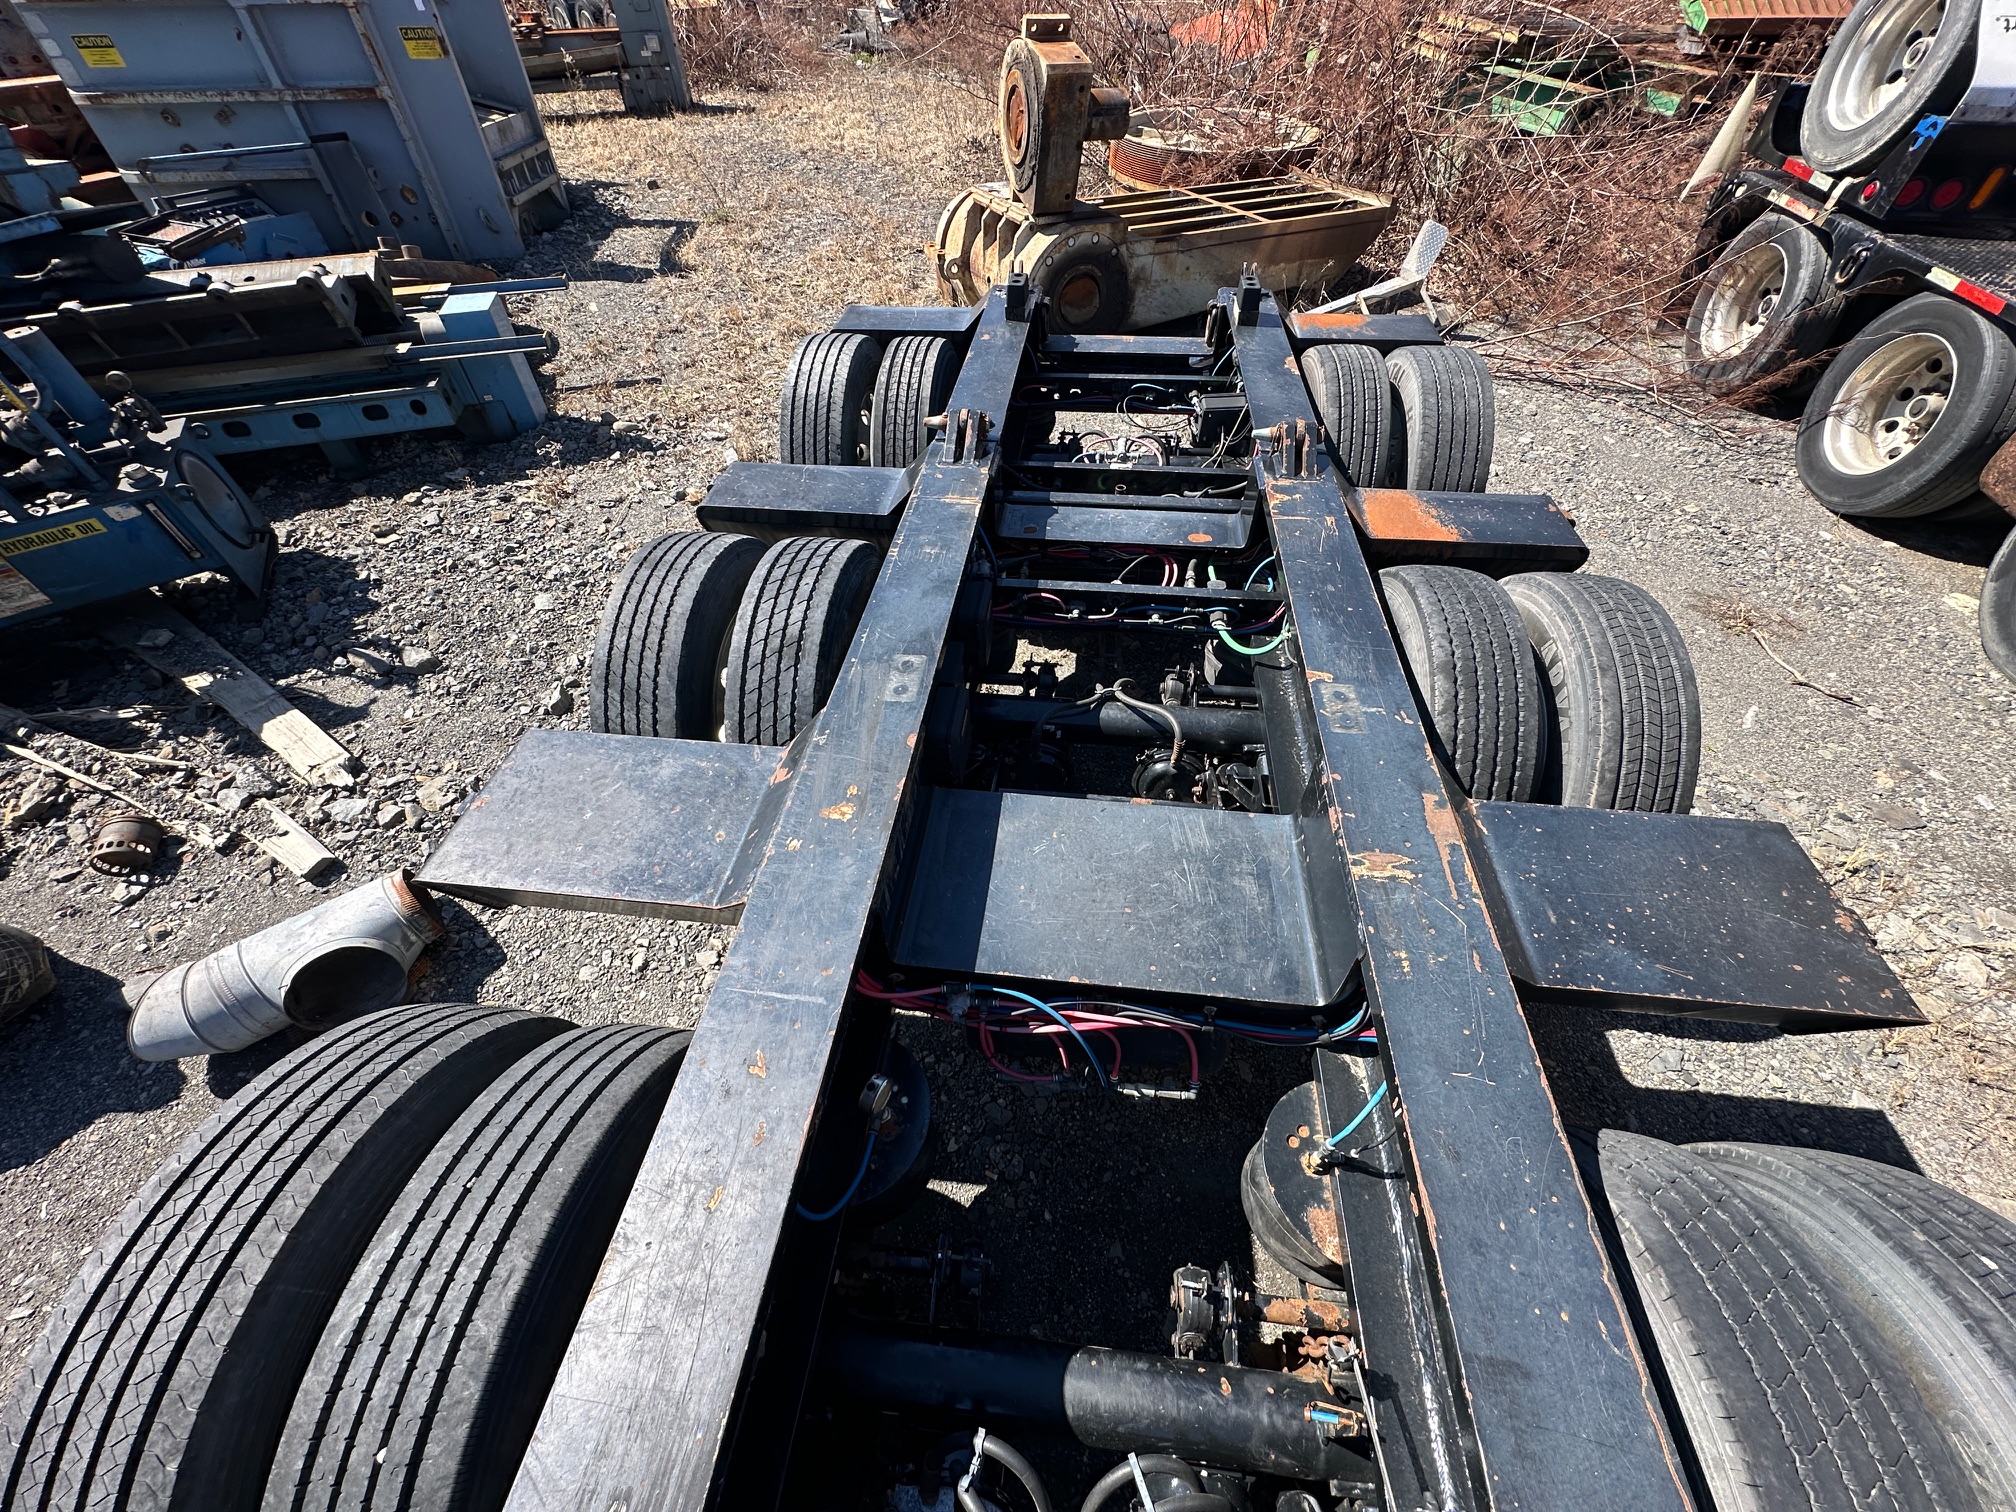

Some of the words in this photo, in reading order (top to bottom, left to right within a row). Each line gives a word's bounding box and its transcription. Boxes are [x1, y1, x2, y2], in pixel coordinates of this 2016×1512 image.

[402, 28, 436, 39] CAUTION
[74, 36, 113, 47] CAUTION
[0, 528, 76, 554] HYDRAULIC
[75, 522, 101, 535] OIL
